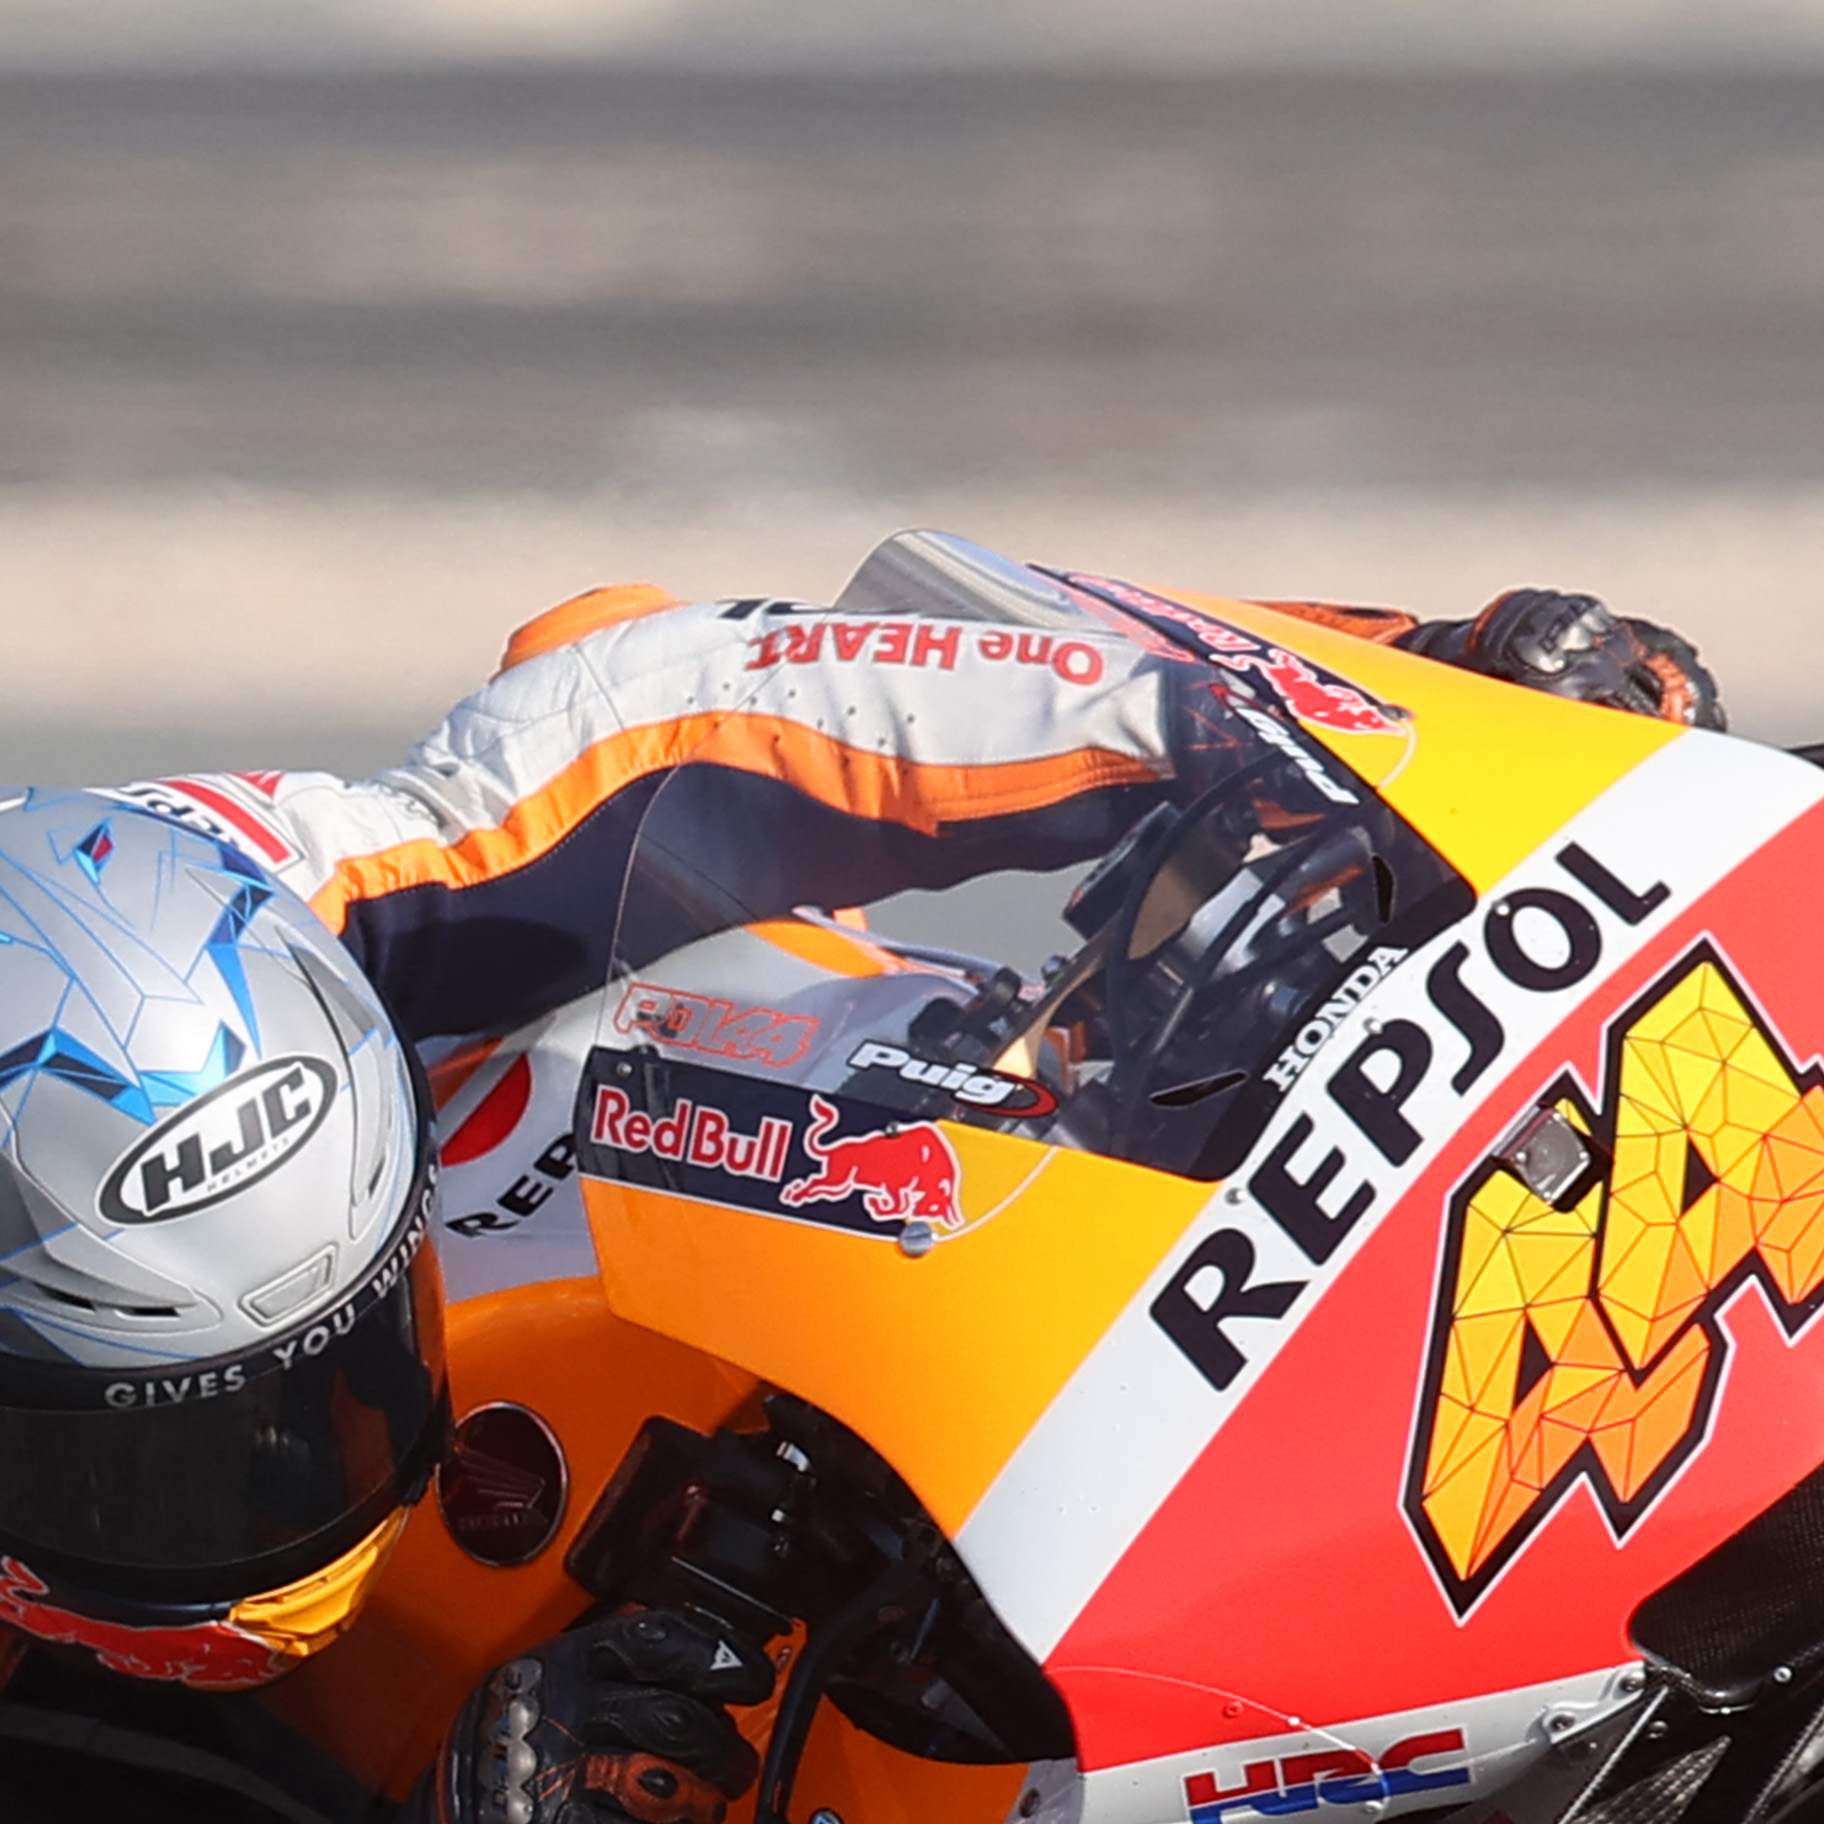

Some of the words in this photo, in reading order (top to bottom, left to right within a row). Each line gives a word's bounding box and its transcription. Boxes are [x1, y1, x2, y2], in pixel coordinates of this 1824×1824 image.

[744, 621, 964, 671] HEART
[979, 630, 1104, 686] One
[612, 981, 821, 1069] POL44
[1263, 946, 1408, 1092] HONDA
[849, 1039, 1018, 1107] Puig
[1149, 841, 1671, 1393] REPSOL
[139, 1065, 313, 1212] HJC
[590, 1083, 690, 1161] Red
[687, 1104, 794, 1183] Bull
[103, 1364, 247, 1408] GIVES
[272, 1303, 357, 1370] YOU
